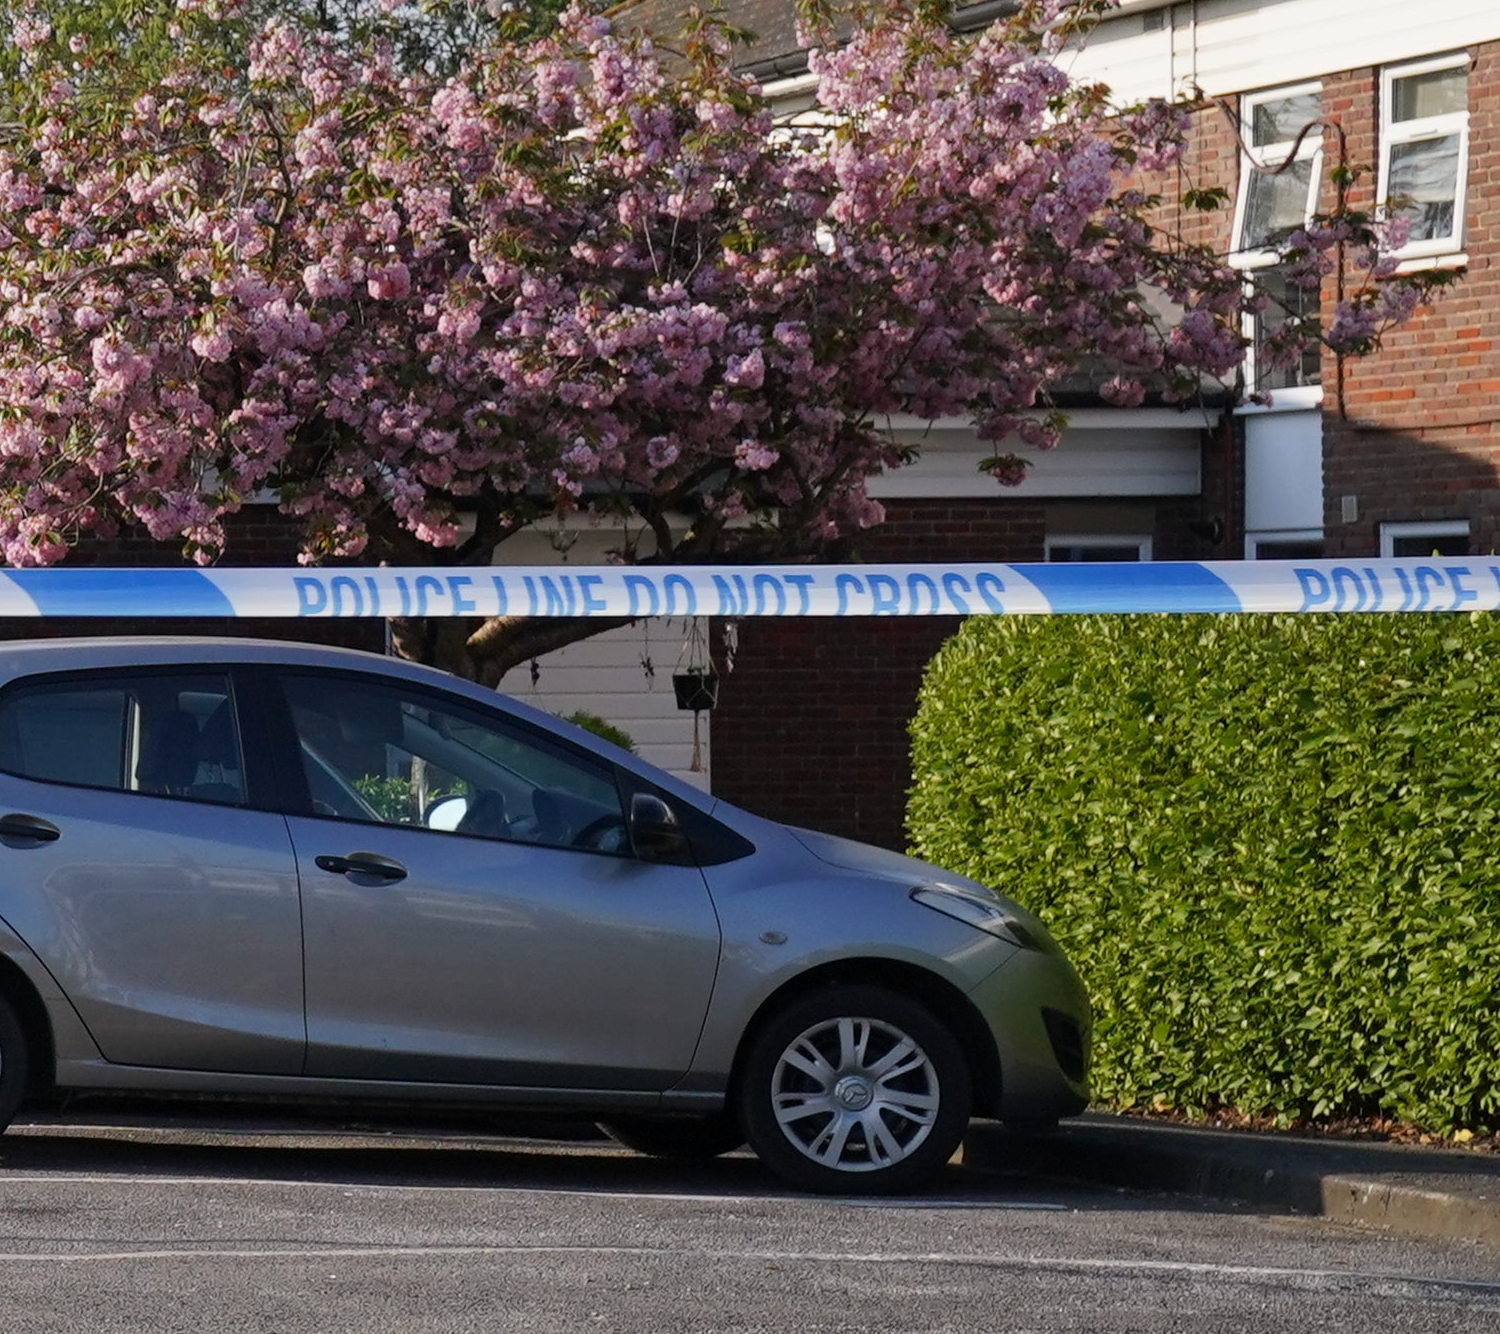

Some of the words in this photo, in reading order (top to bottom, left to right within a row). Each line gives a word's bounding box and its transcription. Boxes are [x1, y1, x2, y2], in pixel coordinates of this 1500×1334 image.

[291, 575, 476, 616] POLICE
[490, 574, 607, 616] LINE
[619, 573, 697, 615] DO
[710, 573, 817, 615] NOT
[832, 570, 1006, 615] CROSS
[1292, 565, 1478, 612] POLICE
